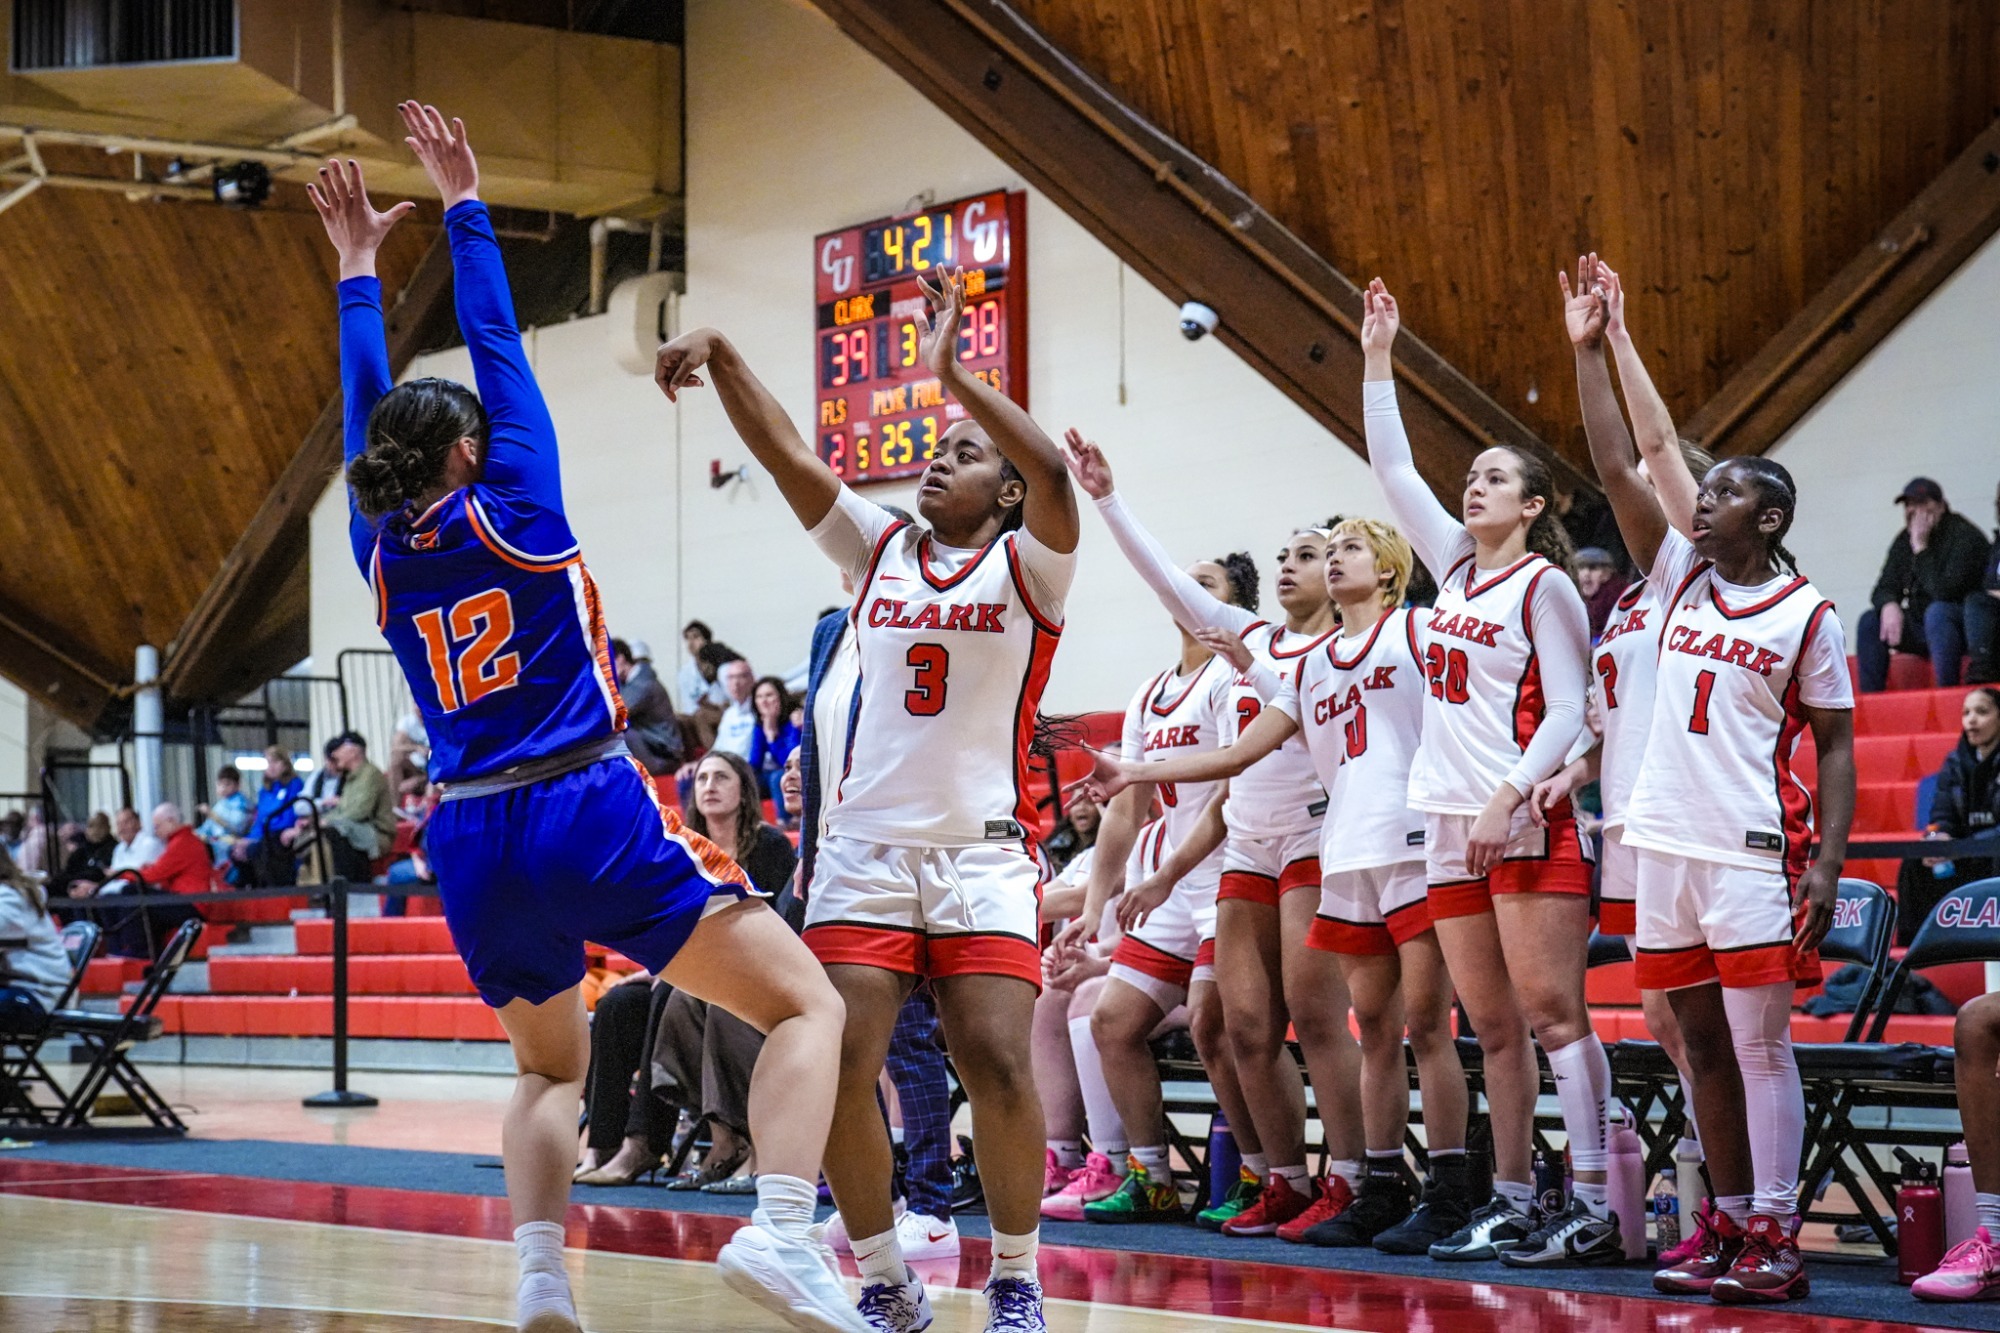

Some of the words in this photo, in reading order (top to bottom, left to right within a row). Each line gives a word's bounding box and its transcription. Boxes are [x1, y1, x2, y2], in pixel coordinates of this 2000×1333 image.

[832, 328, 869, 387] 39
[902, 323, 917, 367] 3
[960, 300, 999, 360] 38
[830, 433, 845, 475] 2
[857, 438, 870, 469] 5
[881, 421, 914, 466] 25
[868, 598, 1007, 633] CLARK
[412, 588, 521, 714] 12
[1426, 642, 1470, 705] 20
[1668, 625, 1784, 676] CLARK
[904, 643, 949, 716] 3
[1688, 669, 1716, 735] 1
